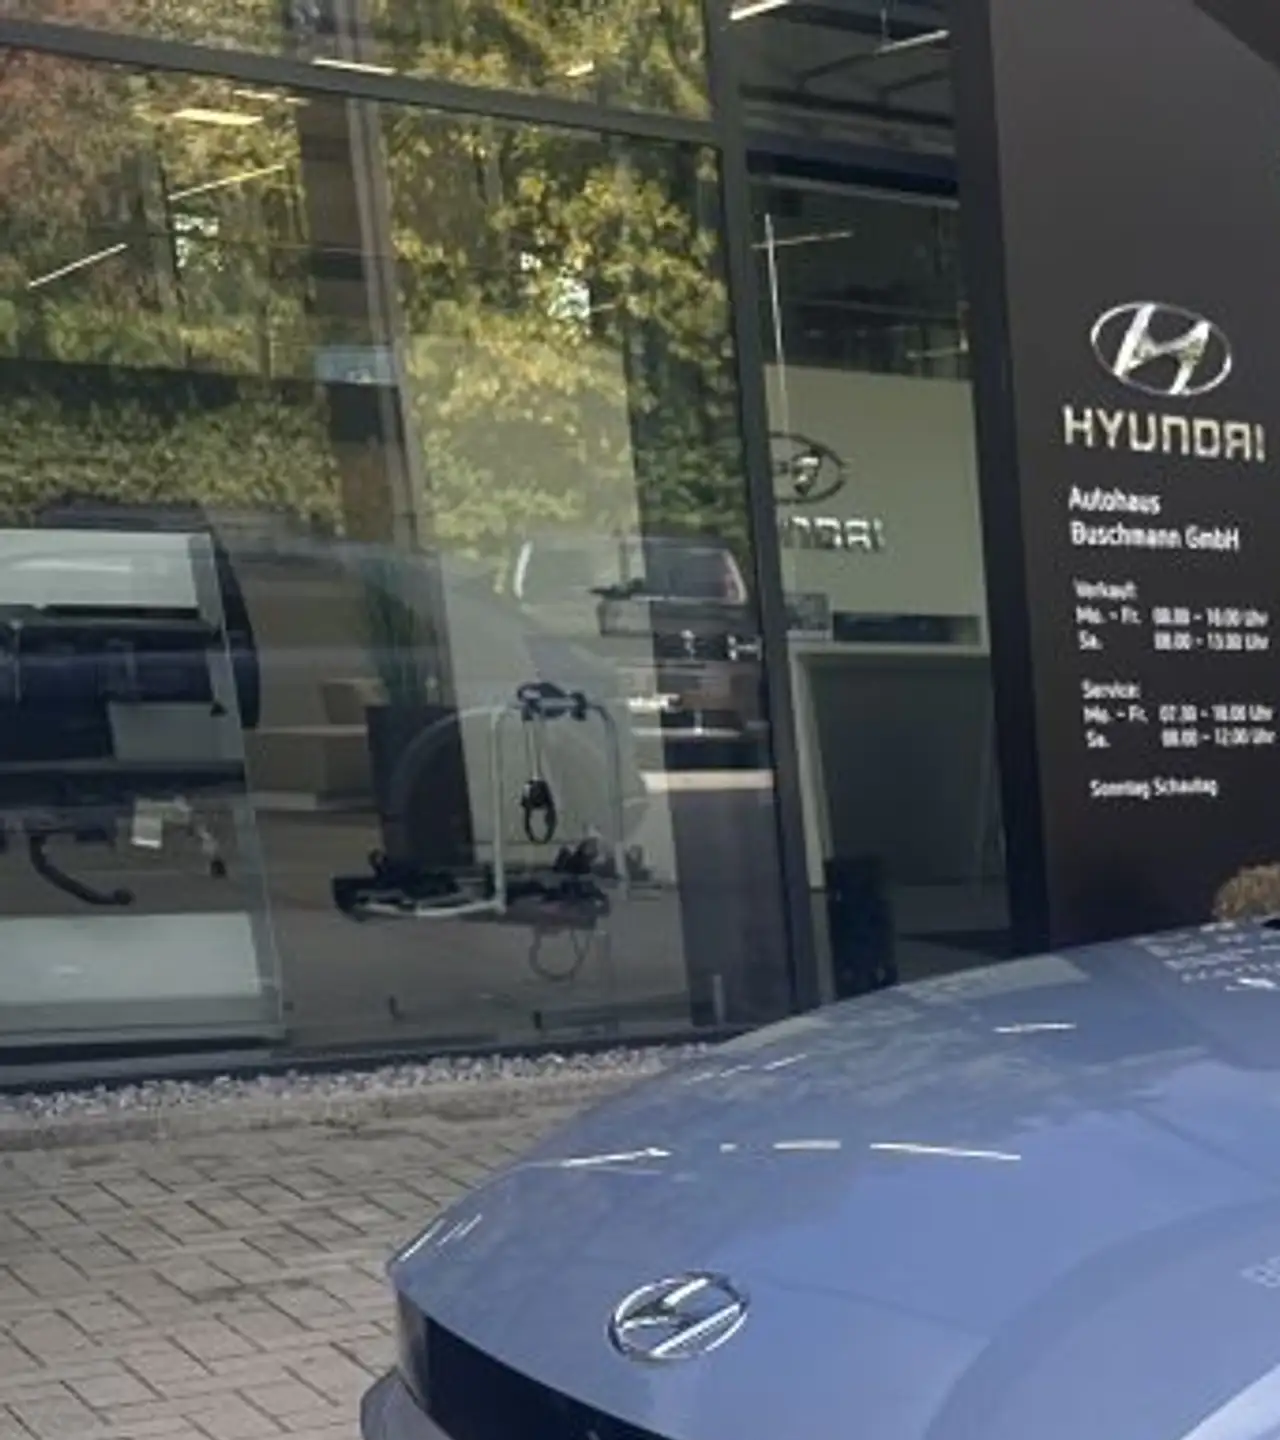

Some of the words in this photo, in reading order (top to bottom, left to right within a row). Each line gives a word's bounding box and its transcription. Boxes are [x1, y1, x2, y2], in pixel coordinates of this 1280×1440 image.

[1063, 404, 1266, 463] HYUNDAI
[1068, 485, 1162, 515] Autohaus
[1070, 519, 1183, 549] Buschmann
[1185, 524, 1241, 552] GmbH
[1245, 631, 1270, 651] Uhr
[1249, 703, 1274, 723] Uhr
